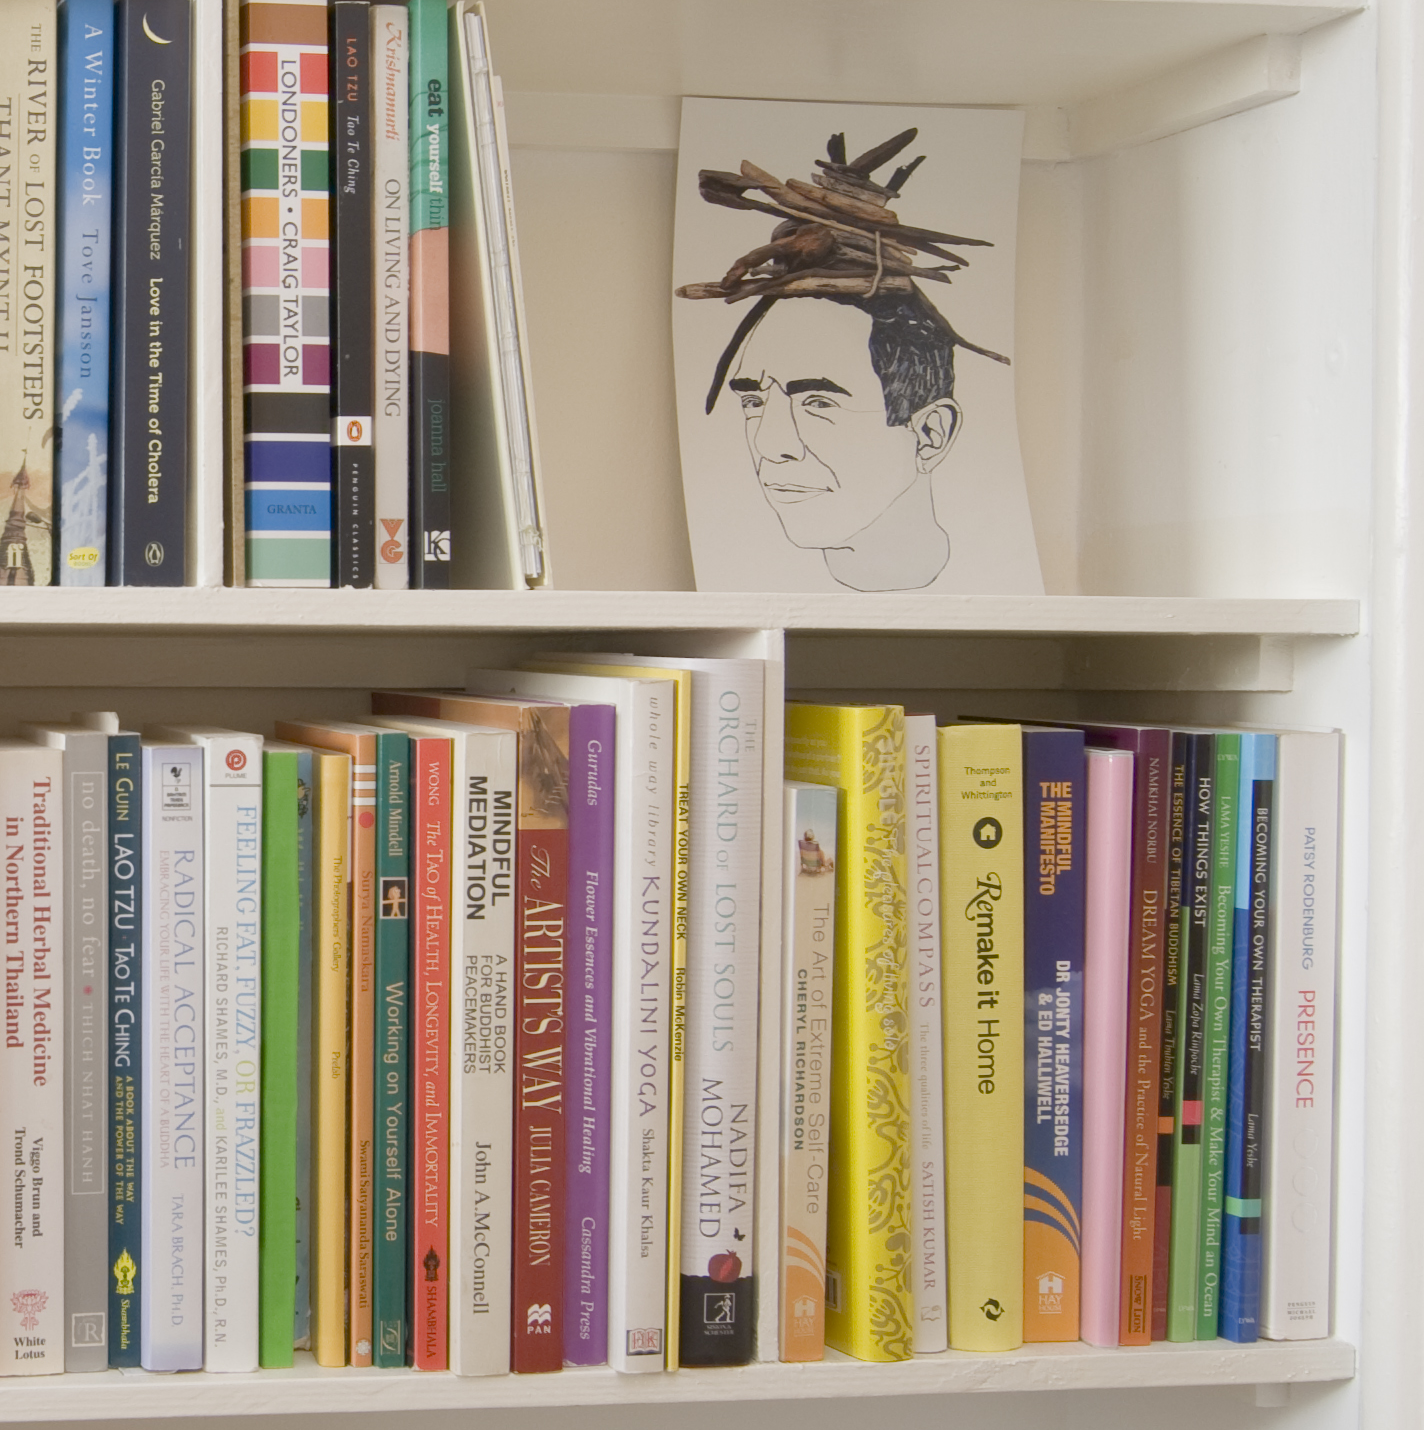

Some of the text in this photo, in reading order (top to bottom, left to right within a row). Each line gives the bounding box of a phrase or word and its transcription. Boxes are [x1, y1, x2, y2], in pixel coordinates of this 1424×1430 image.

[23, 24, 47, 420] THE RIVER OF LOST FOOTSTEPS
[147, 79, 166, 504] Gabriel García Márquez Love in the Time of Cholera
[281, 60, 299, 378] LONDONERS CRAIG TAYLOR
[267, 504, 317, 515] GRANTA
[961, 790, 1012, 801] Whittington
[964, 766, 1010, 776] Thompson
[980, 777, 996, 787] and
[1040, 782, 1072, 798] THE
[1055, 801, 1072, 875] MINDFUL
[466, 776, 488, 920] MEDIATION
[491, 790, 512, 907] MINDFUL
[1040, 802, 1055, 895] MANIFESTO
[1194, 777, 1211, 927] HOW THINGS EXIST
[6, 817, 24, 1049] in Northern Thailand
[33, 777, 52, 1087] Traditional Herbal Medicine
[965, 872, 1002, 1095] Remake it Home
[1295, 827, 1316, 1109] PATSY RODENBURG PRESENCE
[522, 845, 565, 1266] The ARTIST'S WAY JULIA CAMERON
[794, 968, 807, 1150] CHERYL RICHARDSON
[14, 1336, 46, 1360] White Lotus
